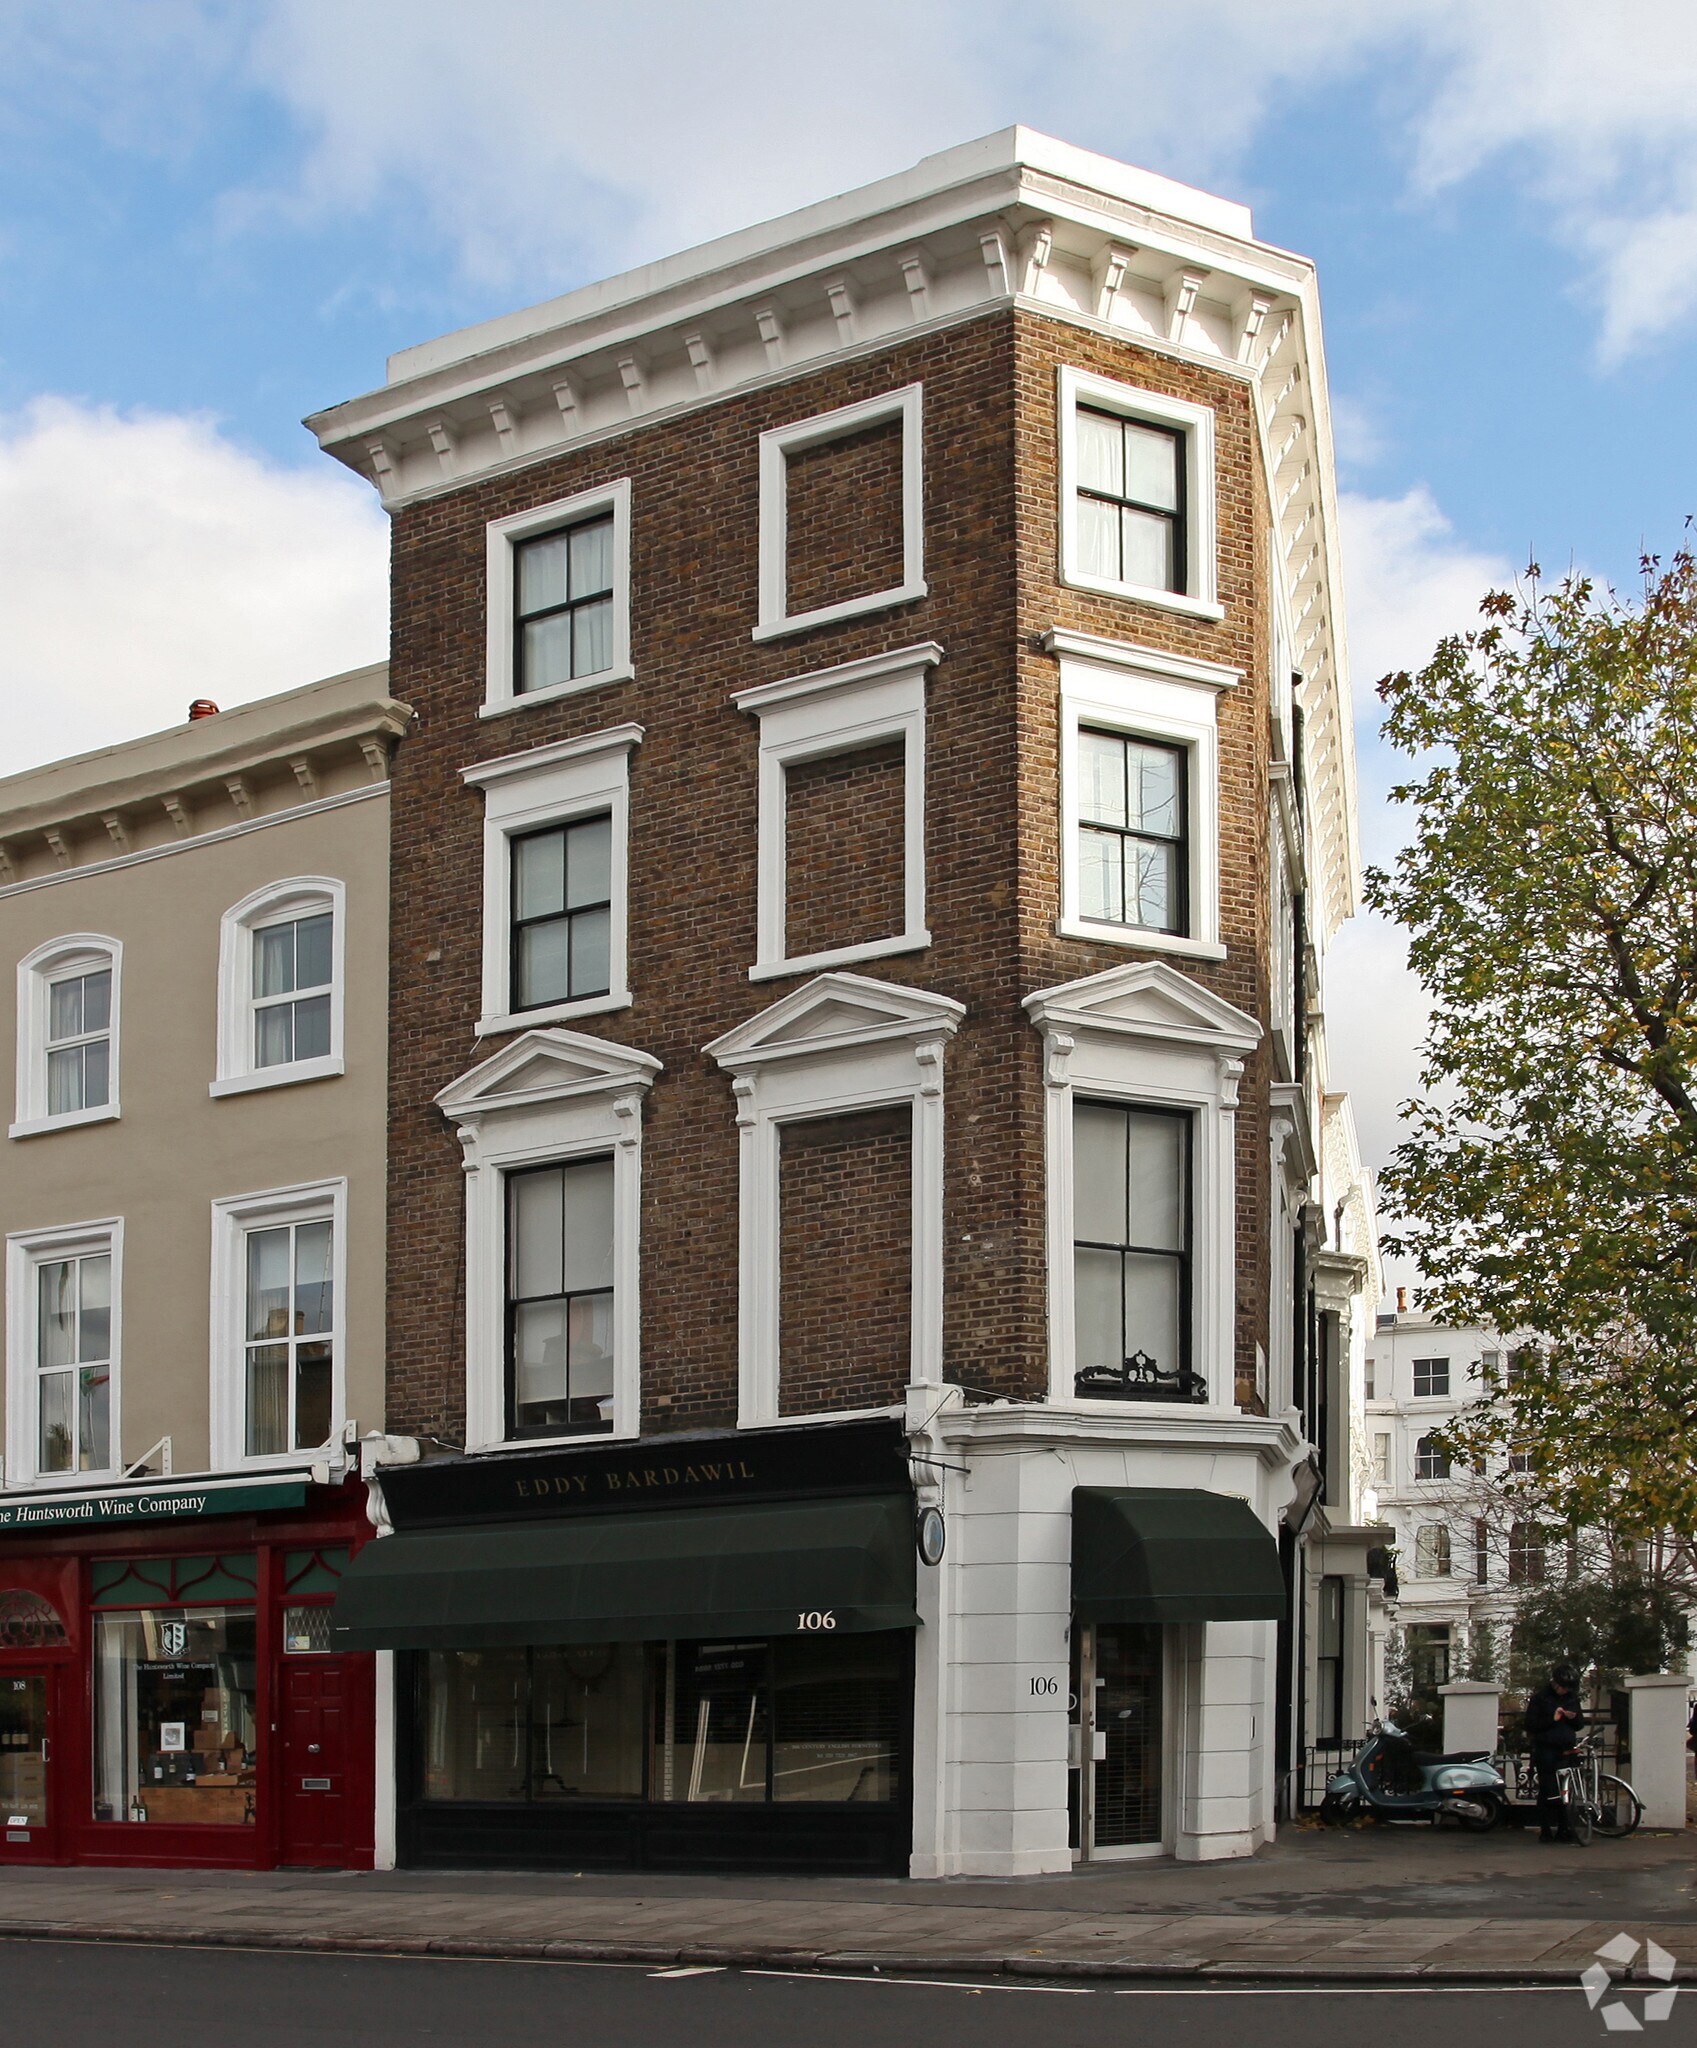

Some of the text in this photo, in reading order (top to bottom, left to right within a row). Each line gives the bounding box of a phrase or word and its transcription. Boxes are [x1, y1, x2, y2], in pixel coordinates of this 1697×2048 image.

[516, 1461, 754, 1497] EDDY BARDAWIL
[15, 1501, 94, 1522] Huntsworth
[99, 1500, 134, 1515] Wine
[138, 1496, 207, 1514] Company
[797, 1610, 837, 1630] 106
[190, 1661, 216, 1670] Company
[1029, 1676, 1058, 1696] 106
